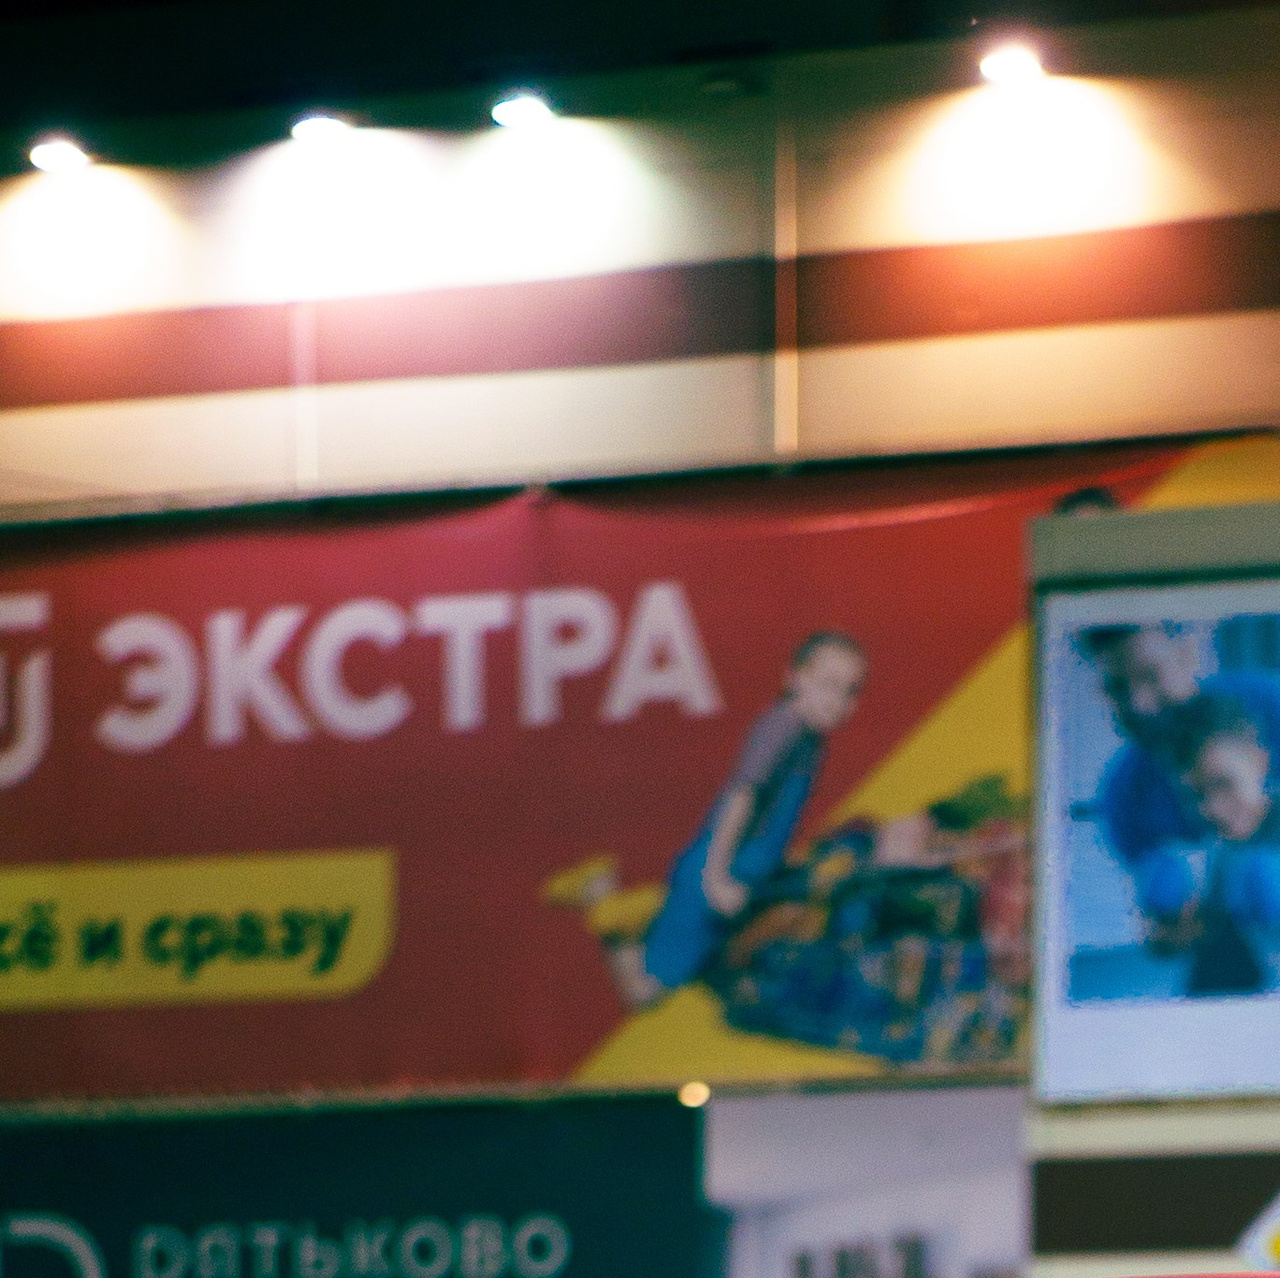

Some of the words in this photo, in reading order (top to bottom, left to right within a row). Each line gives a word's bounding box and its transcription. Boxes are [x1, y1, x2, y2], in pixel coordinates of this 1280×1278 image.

[97, 582, 722, 752] ЭКСТРА
[77, 915, 123, 967] и
[141, 909, 354, 980] сразу
